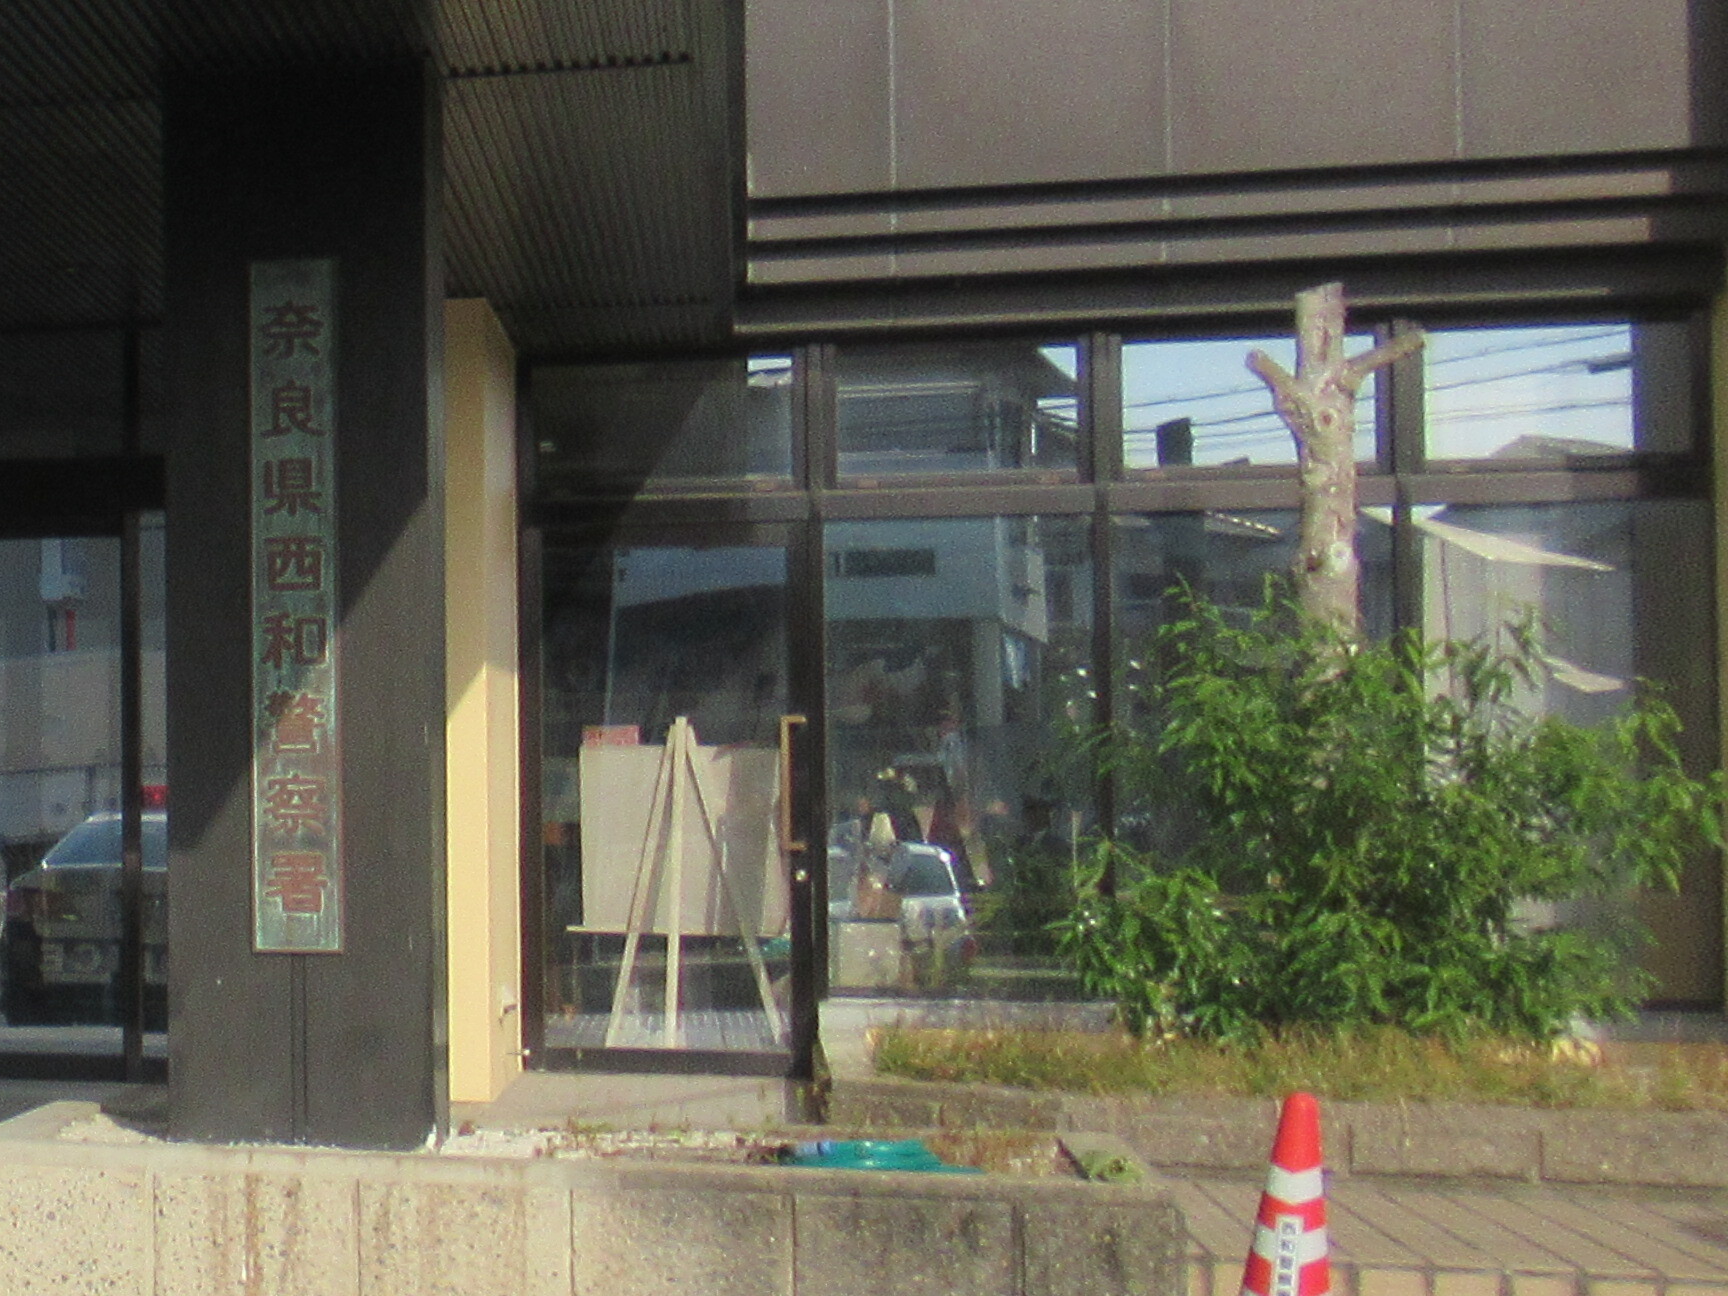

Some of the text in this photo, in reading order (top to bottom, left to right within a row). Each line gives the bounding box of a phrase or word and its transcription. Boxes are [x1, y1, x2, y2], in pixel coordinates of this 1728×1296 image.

[260, 300, 330, 913] 奈良県西和警察署
